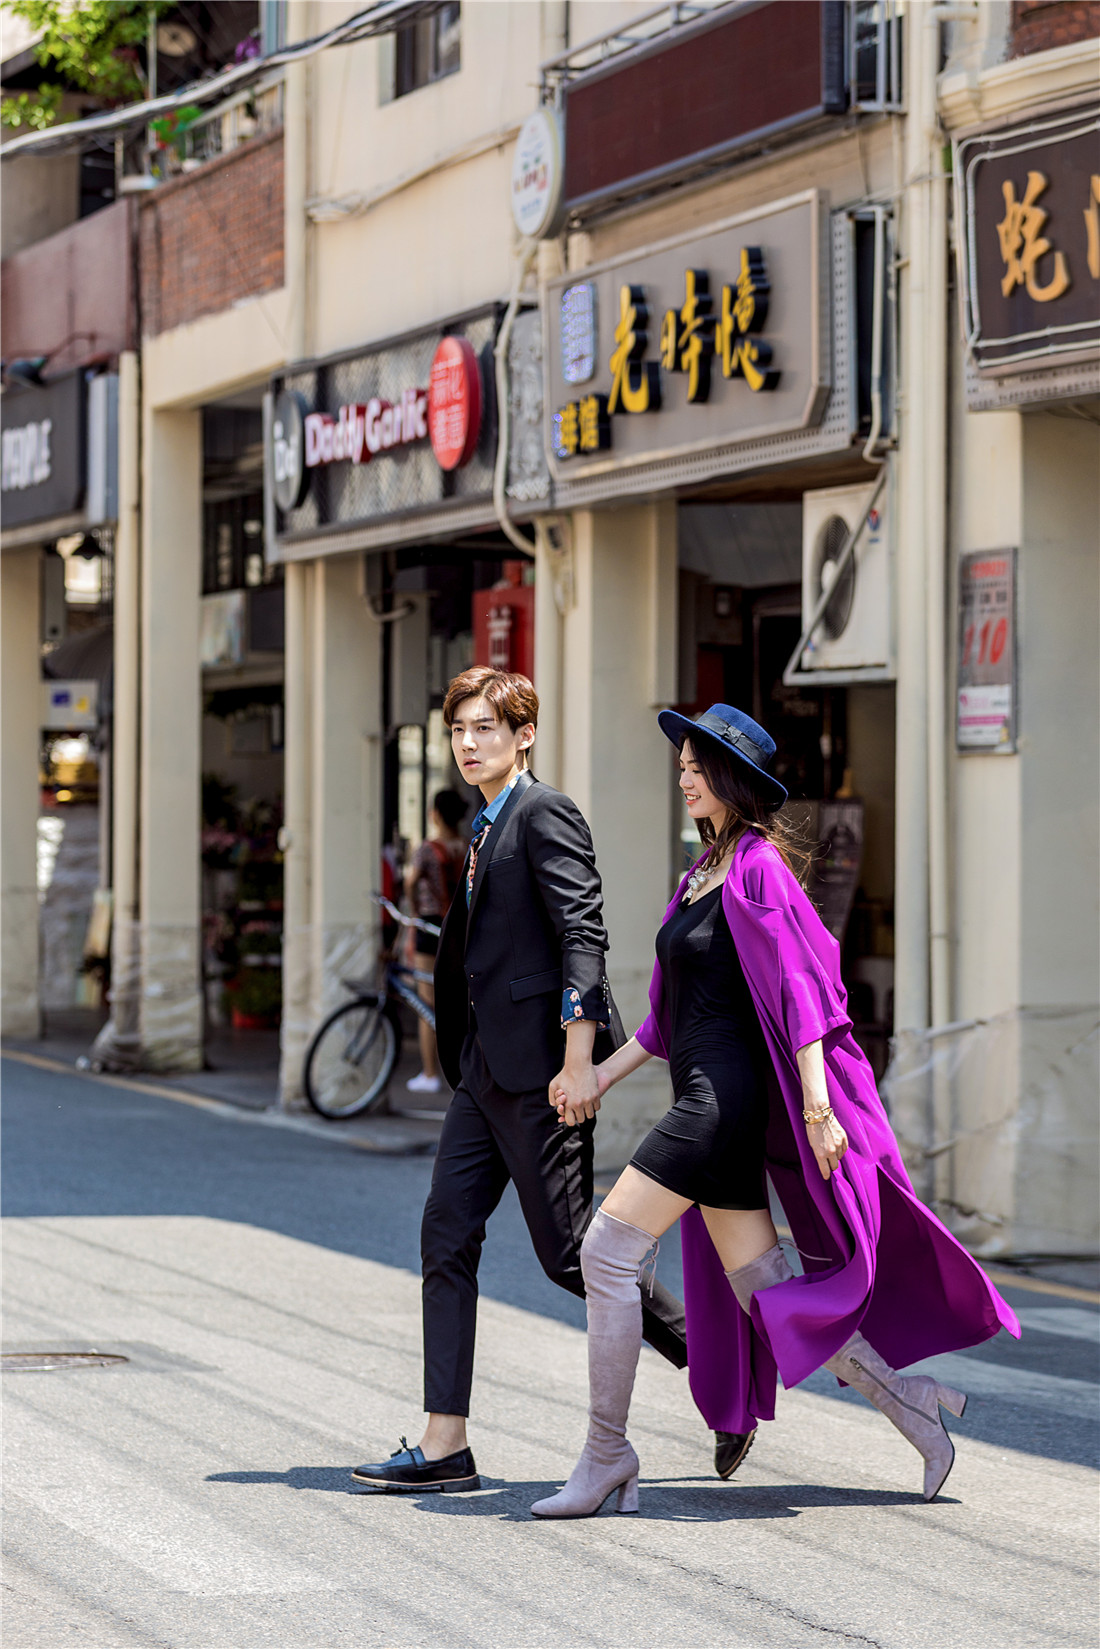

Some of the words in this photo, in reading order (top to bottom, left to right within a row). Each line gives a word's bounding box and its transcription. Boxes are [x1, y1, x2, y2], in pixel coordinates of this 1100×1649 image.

[996, 170, 1100, 303] 蚝
[305, 404, 364, 467] Daddy
[365, 389, 427, 453] Garlic
